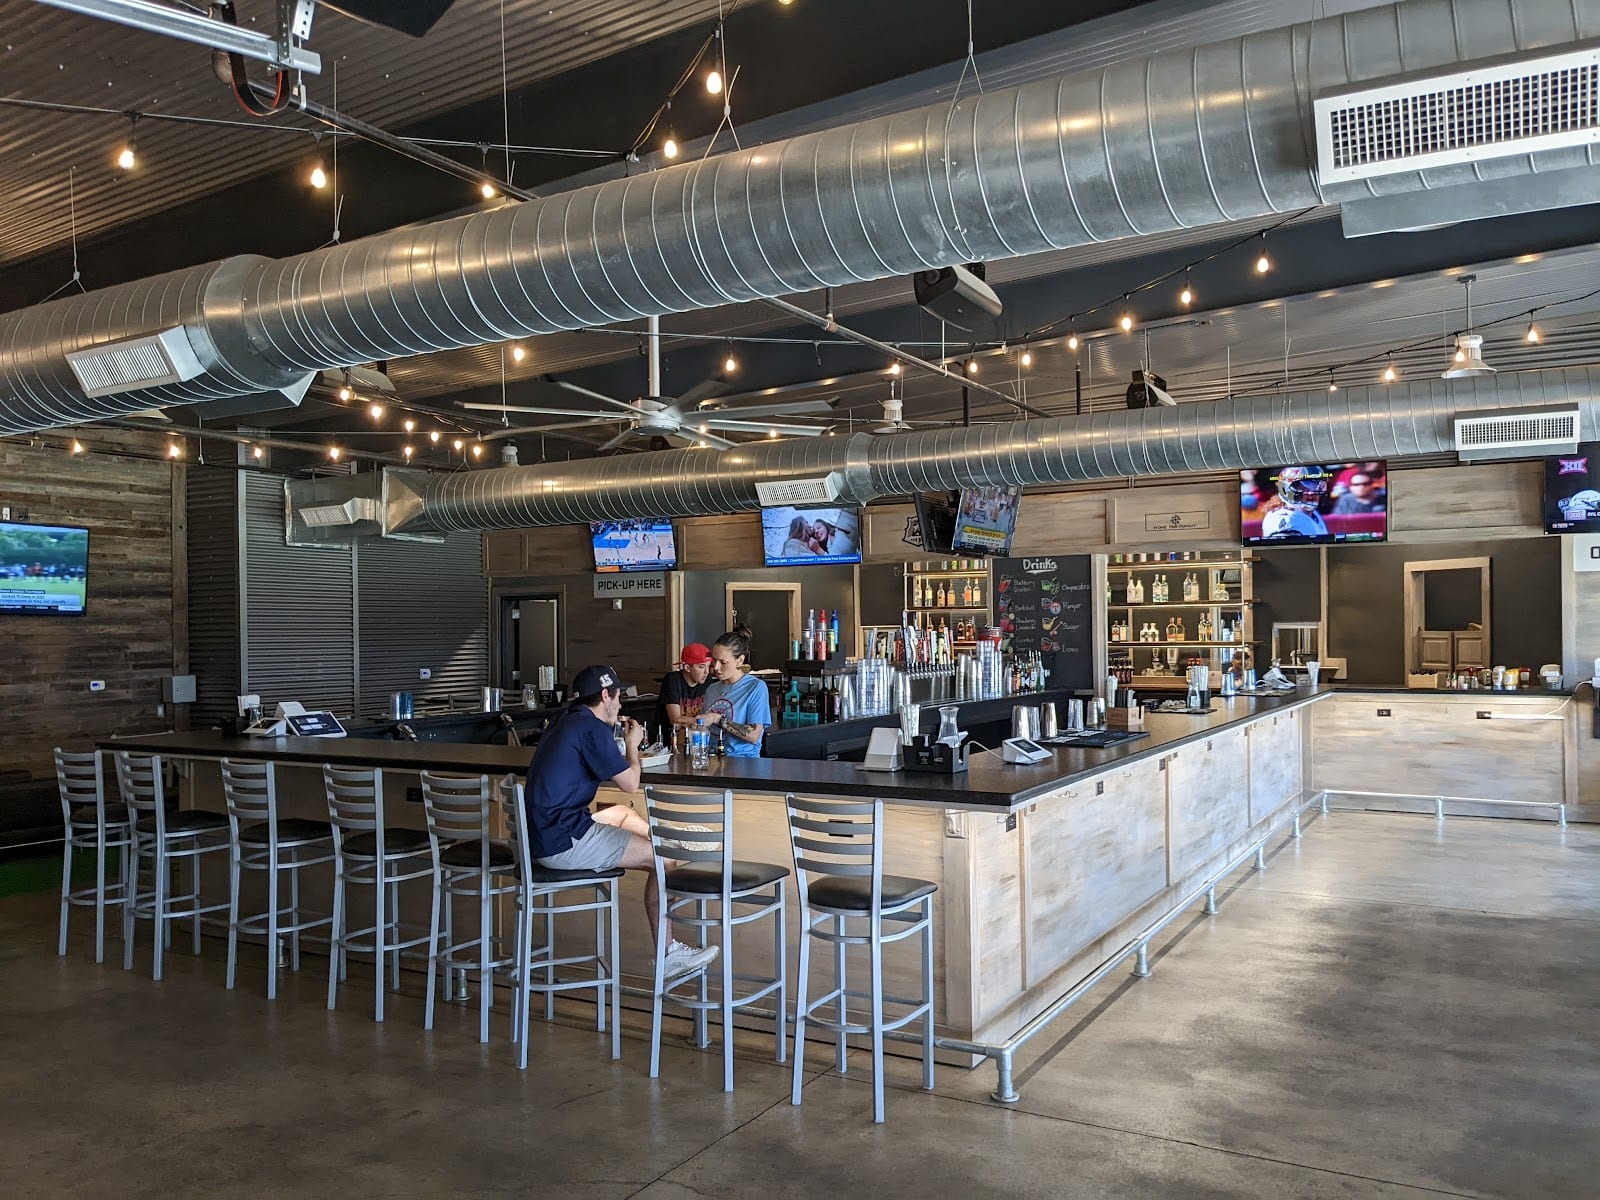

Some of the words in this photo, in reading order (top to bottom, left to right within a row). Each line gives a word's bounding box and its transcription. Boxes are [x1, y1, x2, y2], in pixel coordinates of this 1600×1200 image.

[598, 580, 635, 590] PICK-UP
[637, 579, 662, 589] HERE
[600, 674, 613, 687] 15
